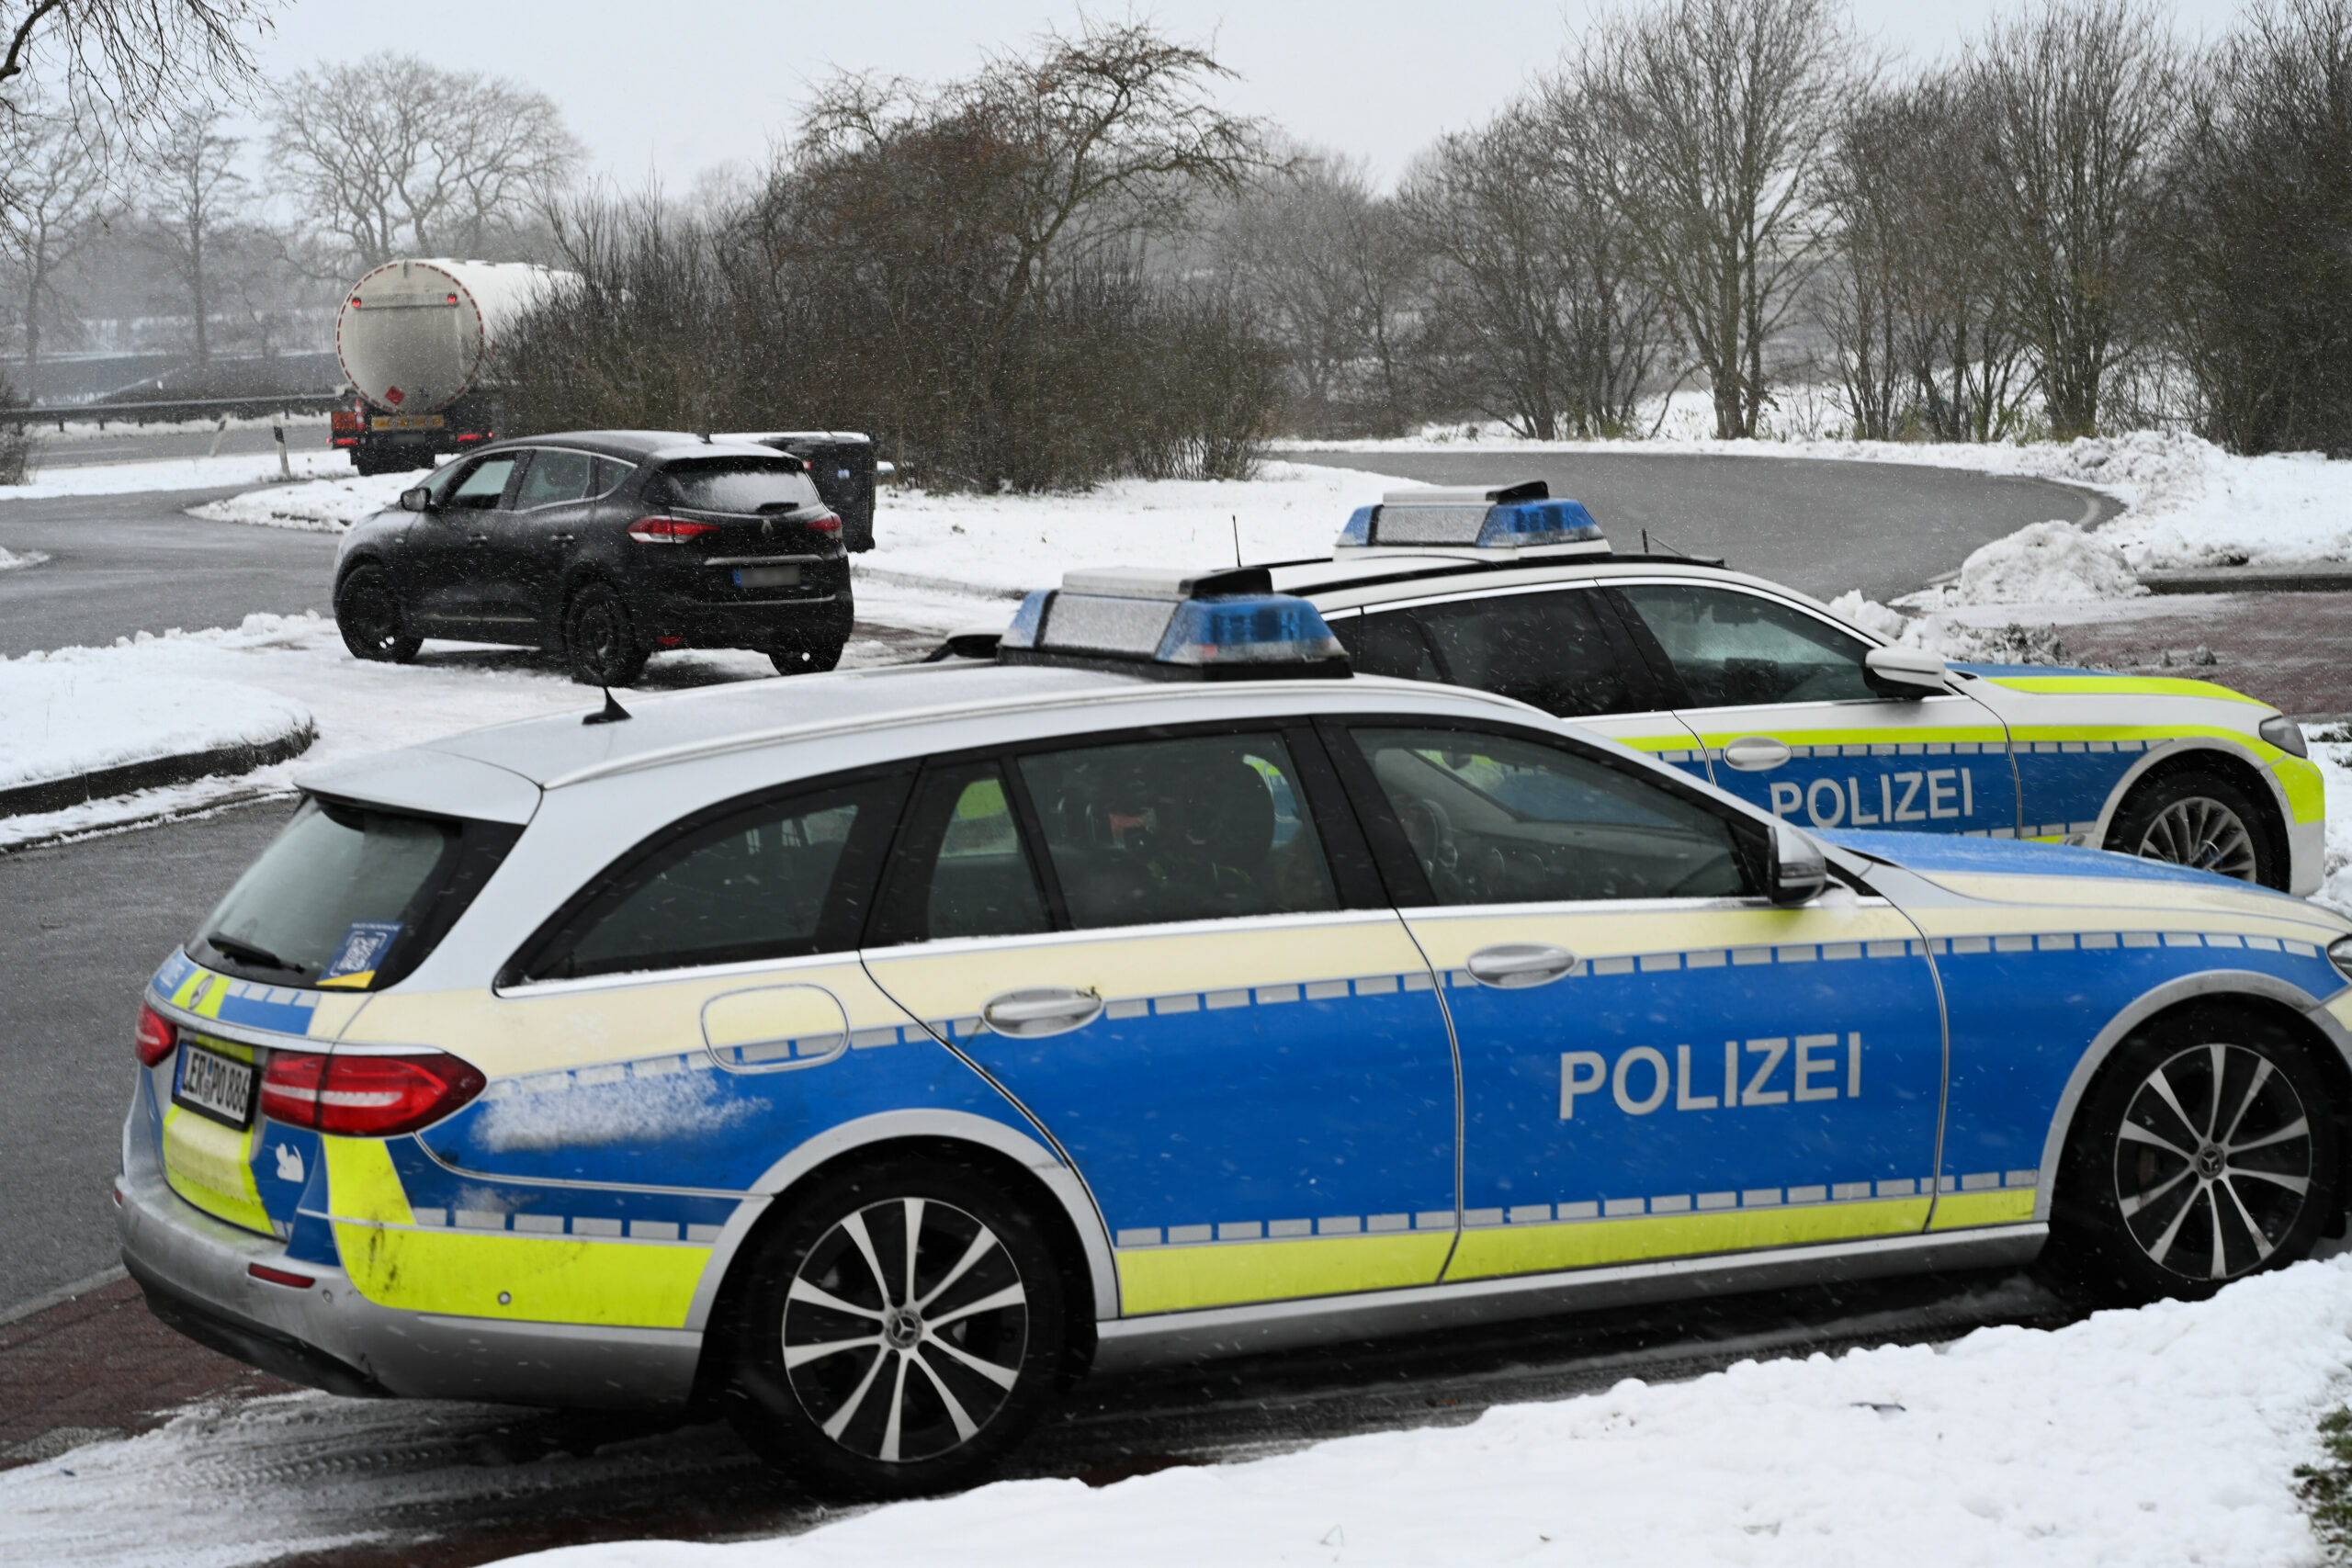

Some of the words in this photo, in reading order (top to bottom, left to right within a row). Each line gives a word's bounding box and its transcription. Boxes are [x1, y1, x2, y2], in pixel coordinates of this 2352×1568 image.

[1770, 767, 1973, 829] POLIZEI
[182, 1050, 206, 1096] LER
[1559, 1032, 1860, 1120] POLIZEI
